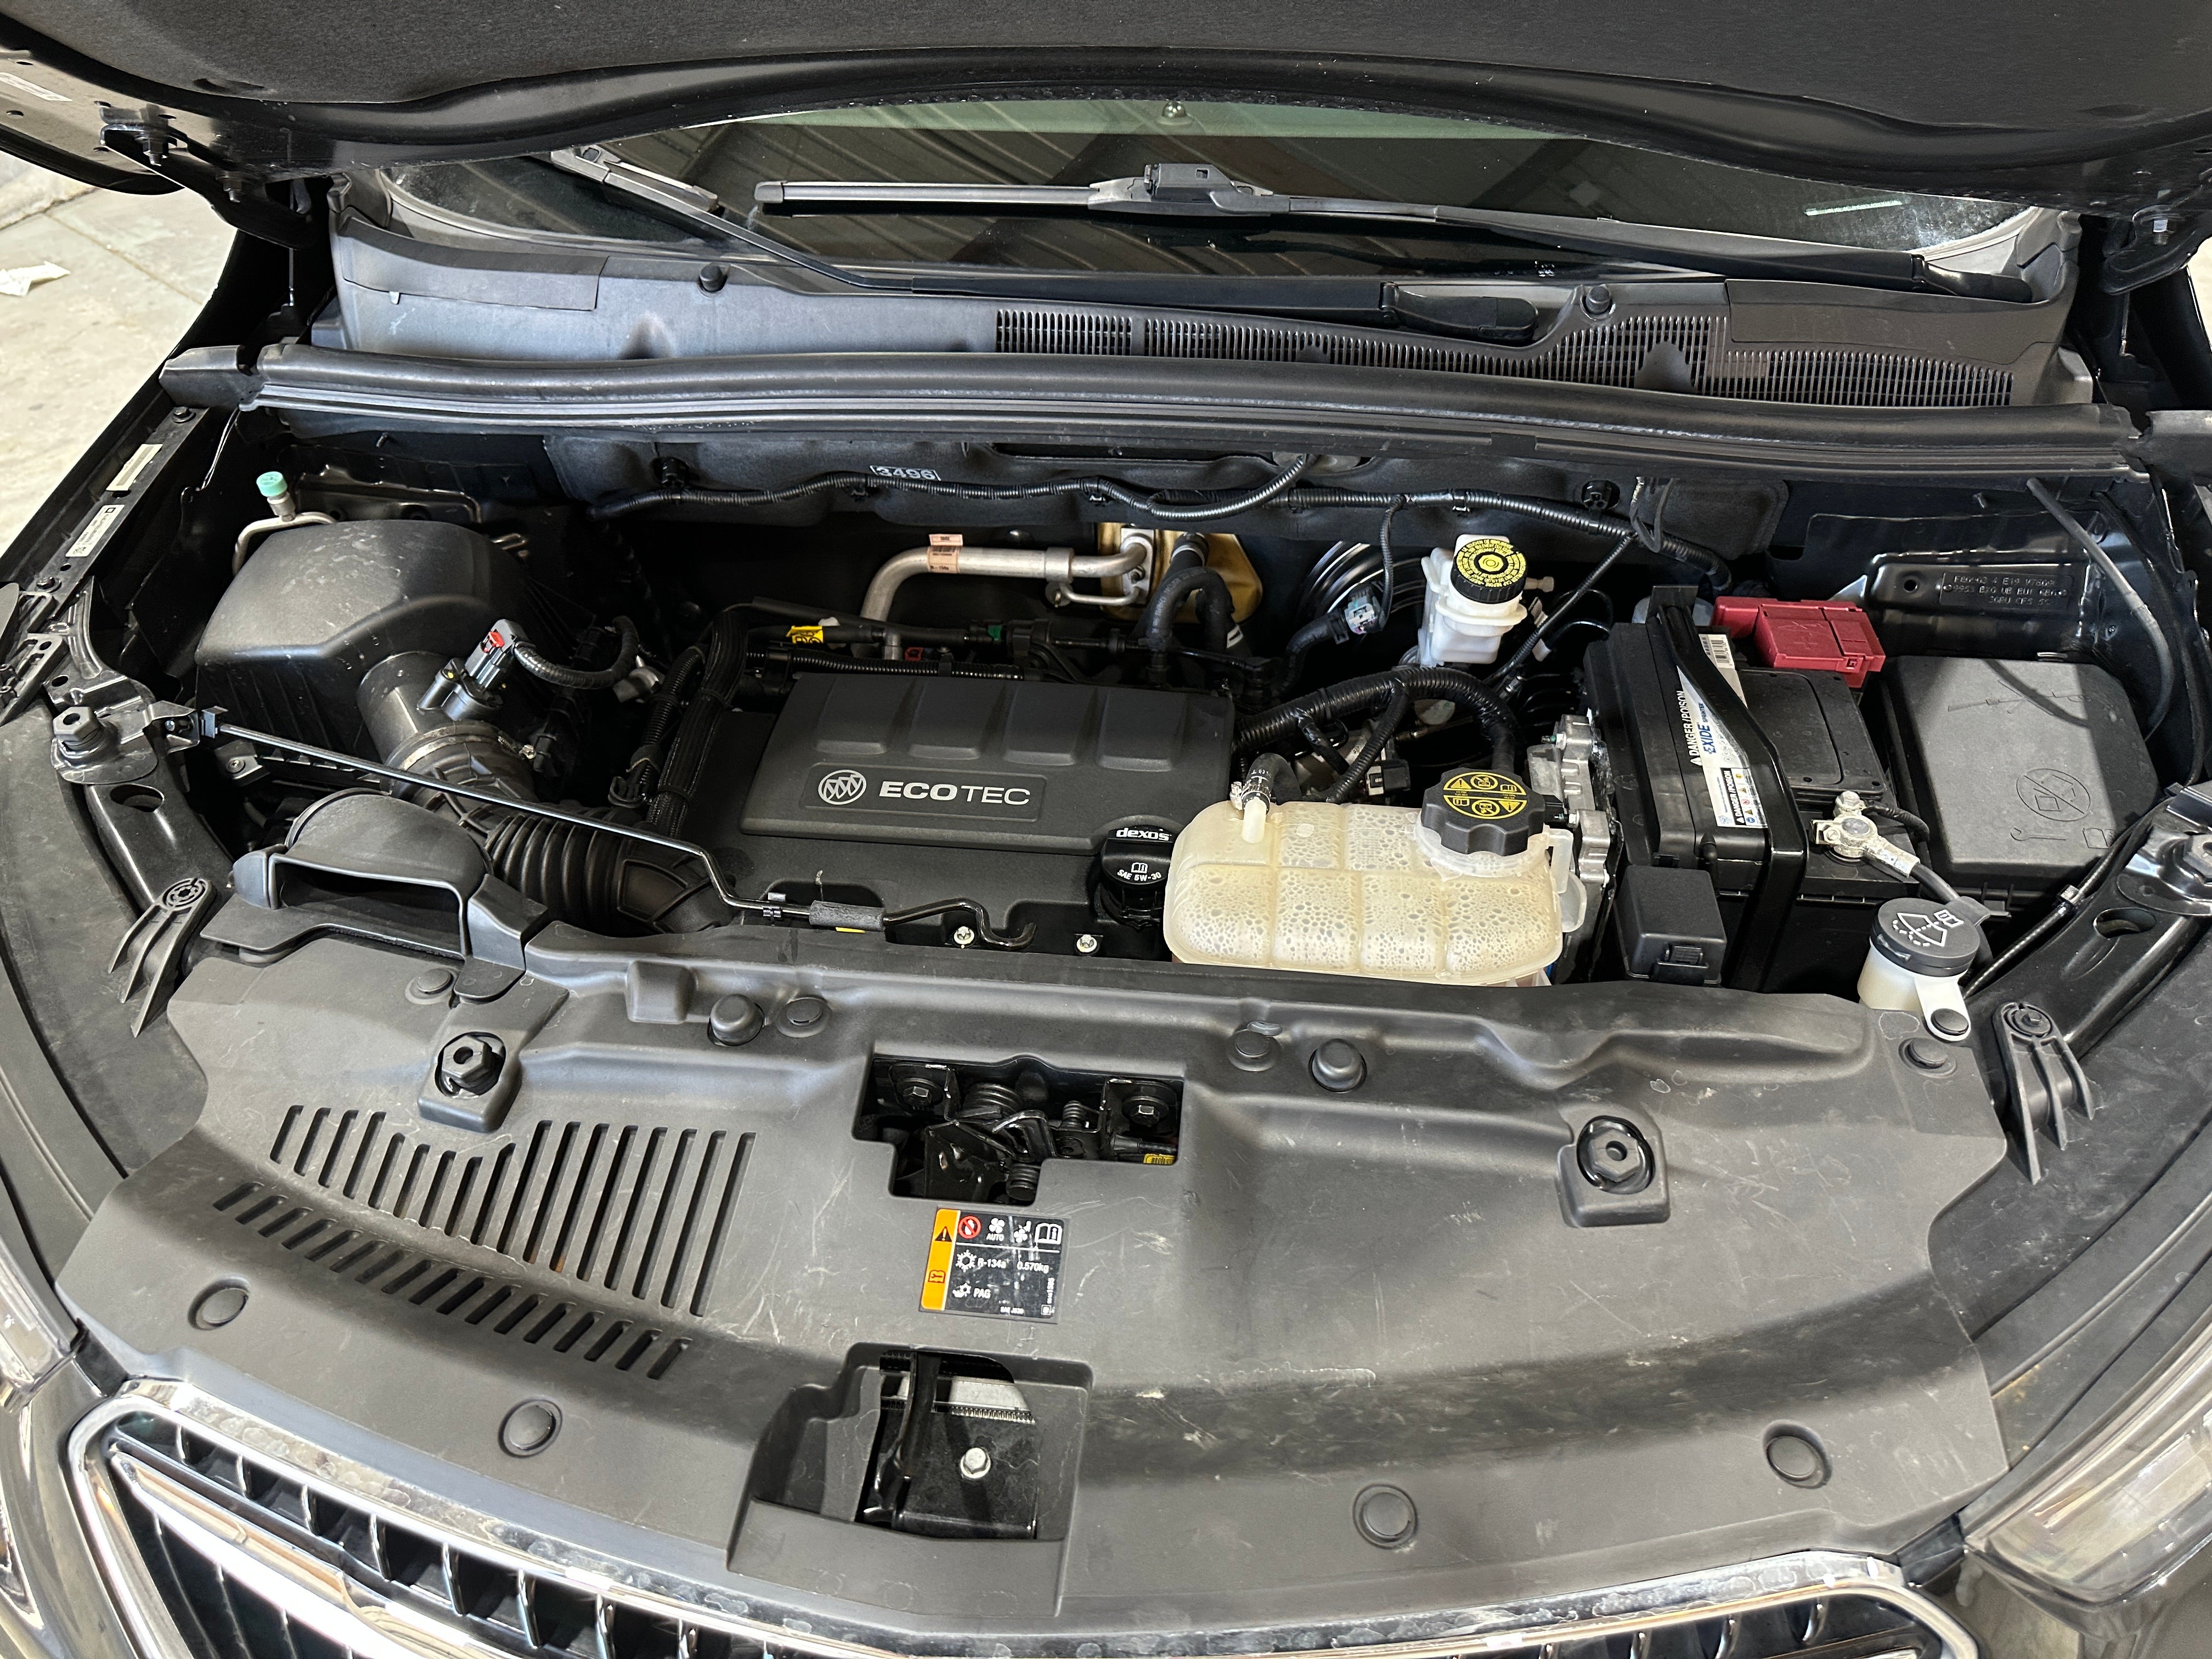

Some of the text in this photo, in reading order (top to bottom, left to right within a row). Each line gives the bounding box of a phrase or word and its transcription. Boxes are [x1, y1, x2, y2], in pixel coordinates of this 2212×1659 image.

[1698, 703, 1708, 723] SPRINTER
[1697, 724, 1716, 754] EXIDE
[879, 781, 1031, 805] ECOTEC
[1116, 827, 1170, 841] dexos
[1117, 869, 1162, 882] SAE 5W-30
[986, 1233, 1004, 1242] AUTO
[977, 1257, 1007, 1269] R-134a
[973, 1288, 991, 1299] PAG
